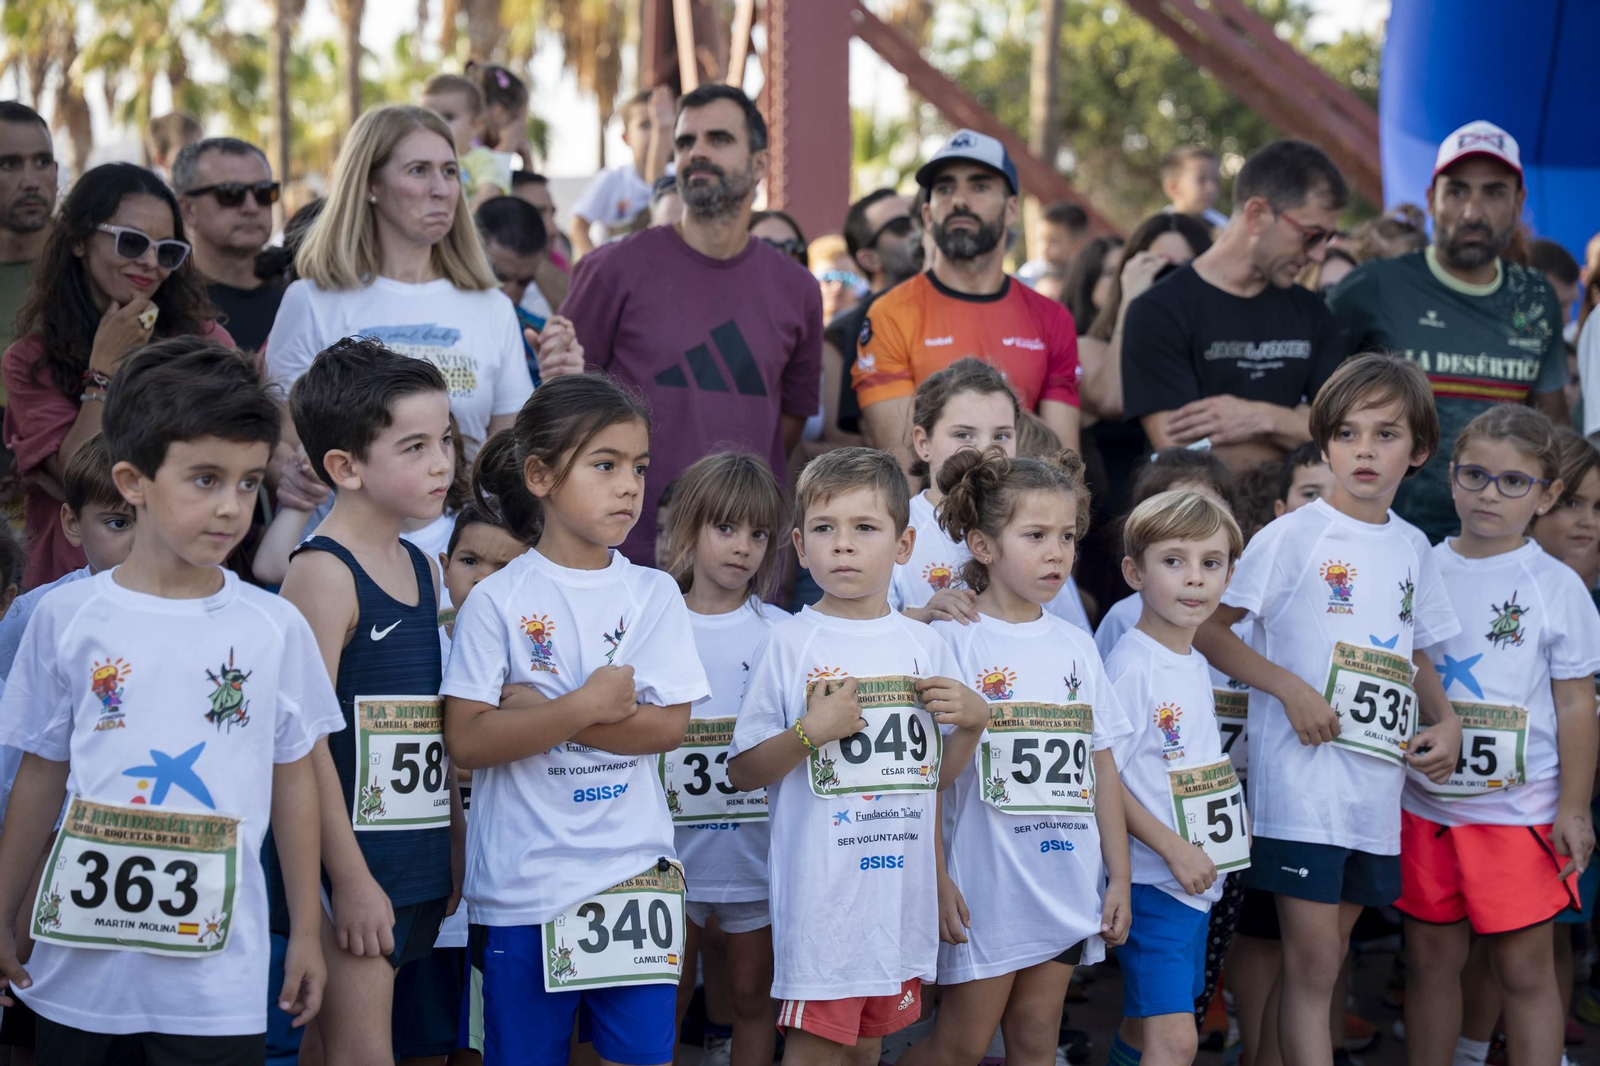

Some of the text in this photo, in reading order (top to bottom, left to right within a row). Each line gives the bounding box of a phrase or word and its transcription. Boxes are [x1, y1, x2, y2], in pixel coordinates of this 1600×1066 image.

[437, 354, 478, 371] WISH
[1326, 606, 1354, 615] AIDA
[530, 662, 559, 676] AIDA
[1344, 659, 1372, 671] ALMERÍA
[858, 694, 896, 704] ROQUETAS
[366, 704, 388, 719] LA
[1350, 681, 1412, 737] 535
[93, 718, 126, 732] AIDA
[373, 719, 408, 729] ALMERÍA
[993, 718, 1025, 727] ALMERÍA
[839, 712, 928, 765] 649
[1162, 750, 1185, 760] AIDA
[1011, 738, 1087, 785] 529
[548, 767, 567, 776] SER
[569, 761, 628, 776] VOLUNTARIO
[881, 766, 905, 776] CÉSAR
[1176, 773, 1195, 786] LA
[1466, 780, 1487, 788] ORTIZ
[1052, 789, 1066, 798] NOA
[1184, 782, 1214, 793] ALMERÍA
[726, 797, 764, 806] IRENE HENS
[855, 808, 899, 821] Fundación
[1014, 825, 1032, 834] SER
[104, 827, 153, 842] ROQUETAS
[155, 833, 168, 843] DE
[171, 835, 190, 845] MAR
[838, 838, 855, 846] SER
[70, 850, 198, 917] 363
[635, 878, 645, 886] DE
[94, 917, 177, 934] MARTÍN MOLINA
[576, 898, 673, 954] 340
[633, 955, 668, 965] CAMILITO
